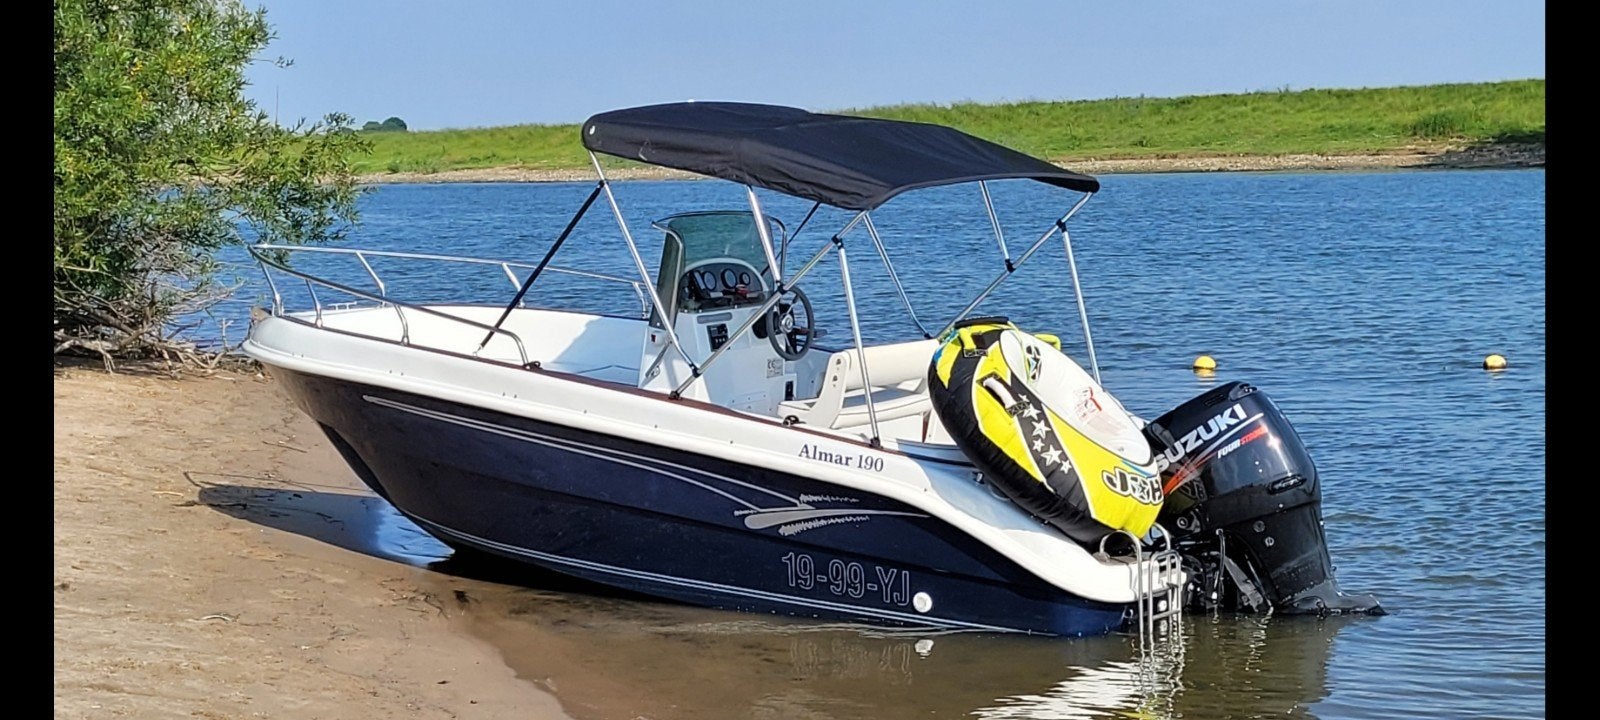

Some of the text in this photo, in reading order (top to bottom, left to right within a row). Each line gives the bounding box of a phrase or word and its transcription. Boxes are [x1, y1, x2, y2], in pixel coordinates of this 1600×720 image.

[798, 443, 884, 472] Almar 190
[1154, 403, 1247, 473] SUZUKI
[782, 552, 910, 606] 19-99-YJ
